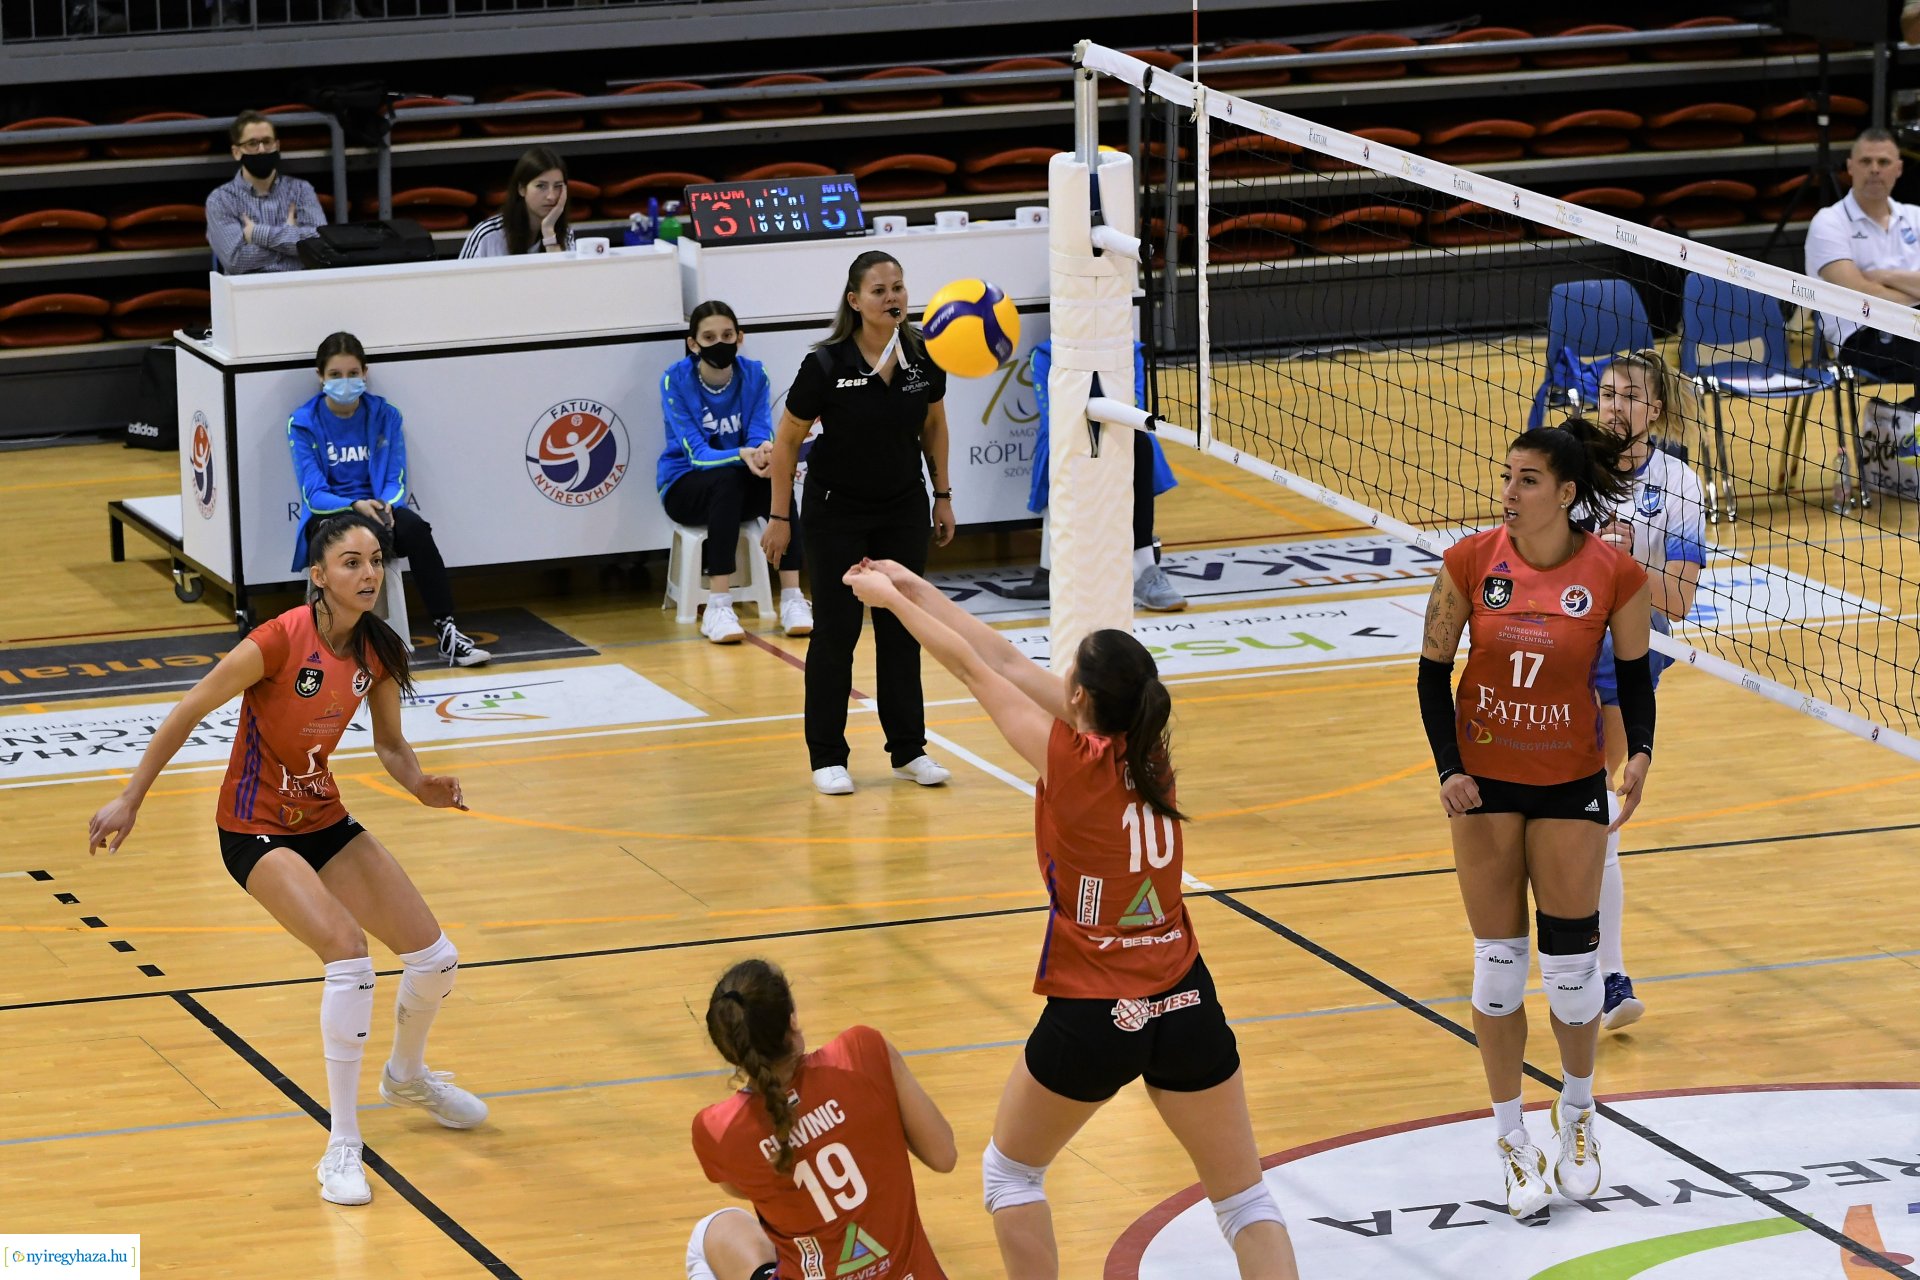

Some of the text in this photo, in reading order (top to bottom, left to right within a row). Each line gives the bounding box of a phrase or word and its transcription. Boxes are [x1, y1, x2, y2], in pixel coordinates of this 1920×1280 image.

[1615, 224, 1639, 247] FATUM
[1791, 279, 1816, 302] FATUM
[836, 378, 868, 388] Zeus
[550, 402, 603, 420] FATUM
[128, 422, 159, 437] adidas
[339, 445, 371, 462] JAK
[1509, 650, 1545, 688] 17
[1477, 684, 1571, 724] FATUM
[1476, 706, 1571, 731] PROPERTY
[1122, 802, 1174, 873] 10
[1083, 879, 1096, 924] STRABAG
[793, 1142, 868, 1223] 19
